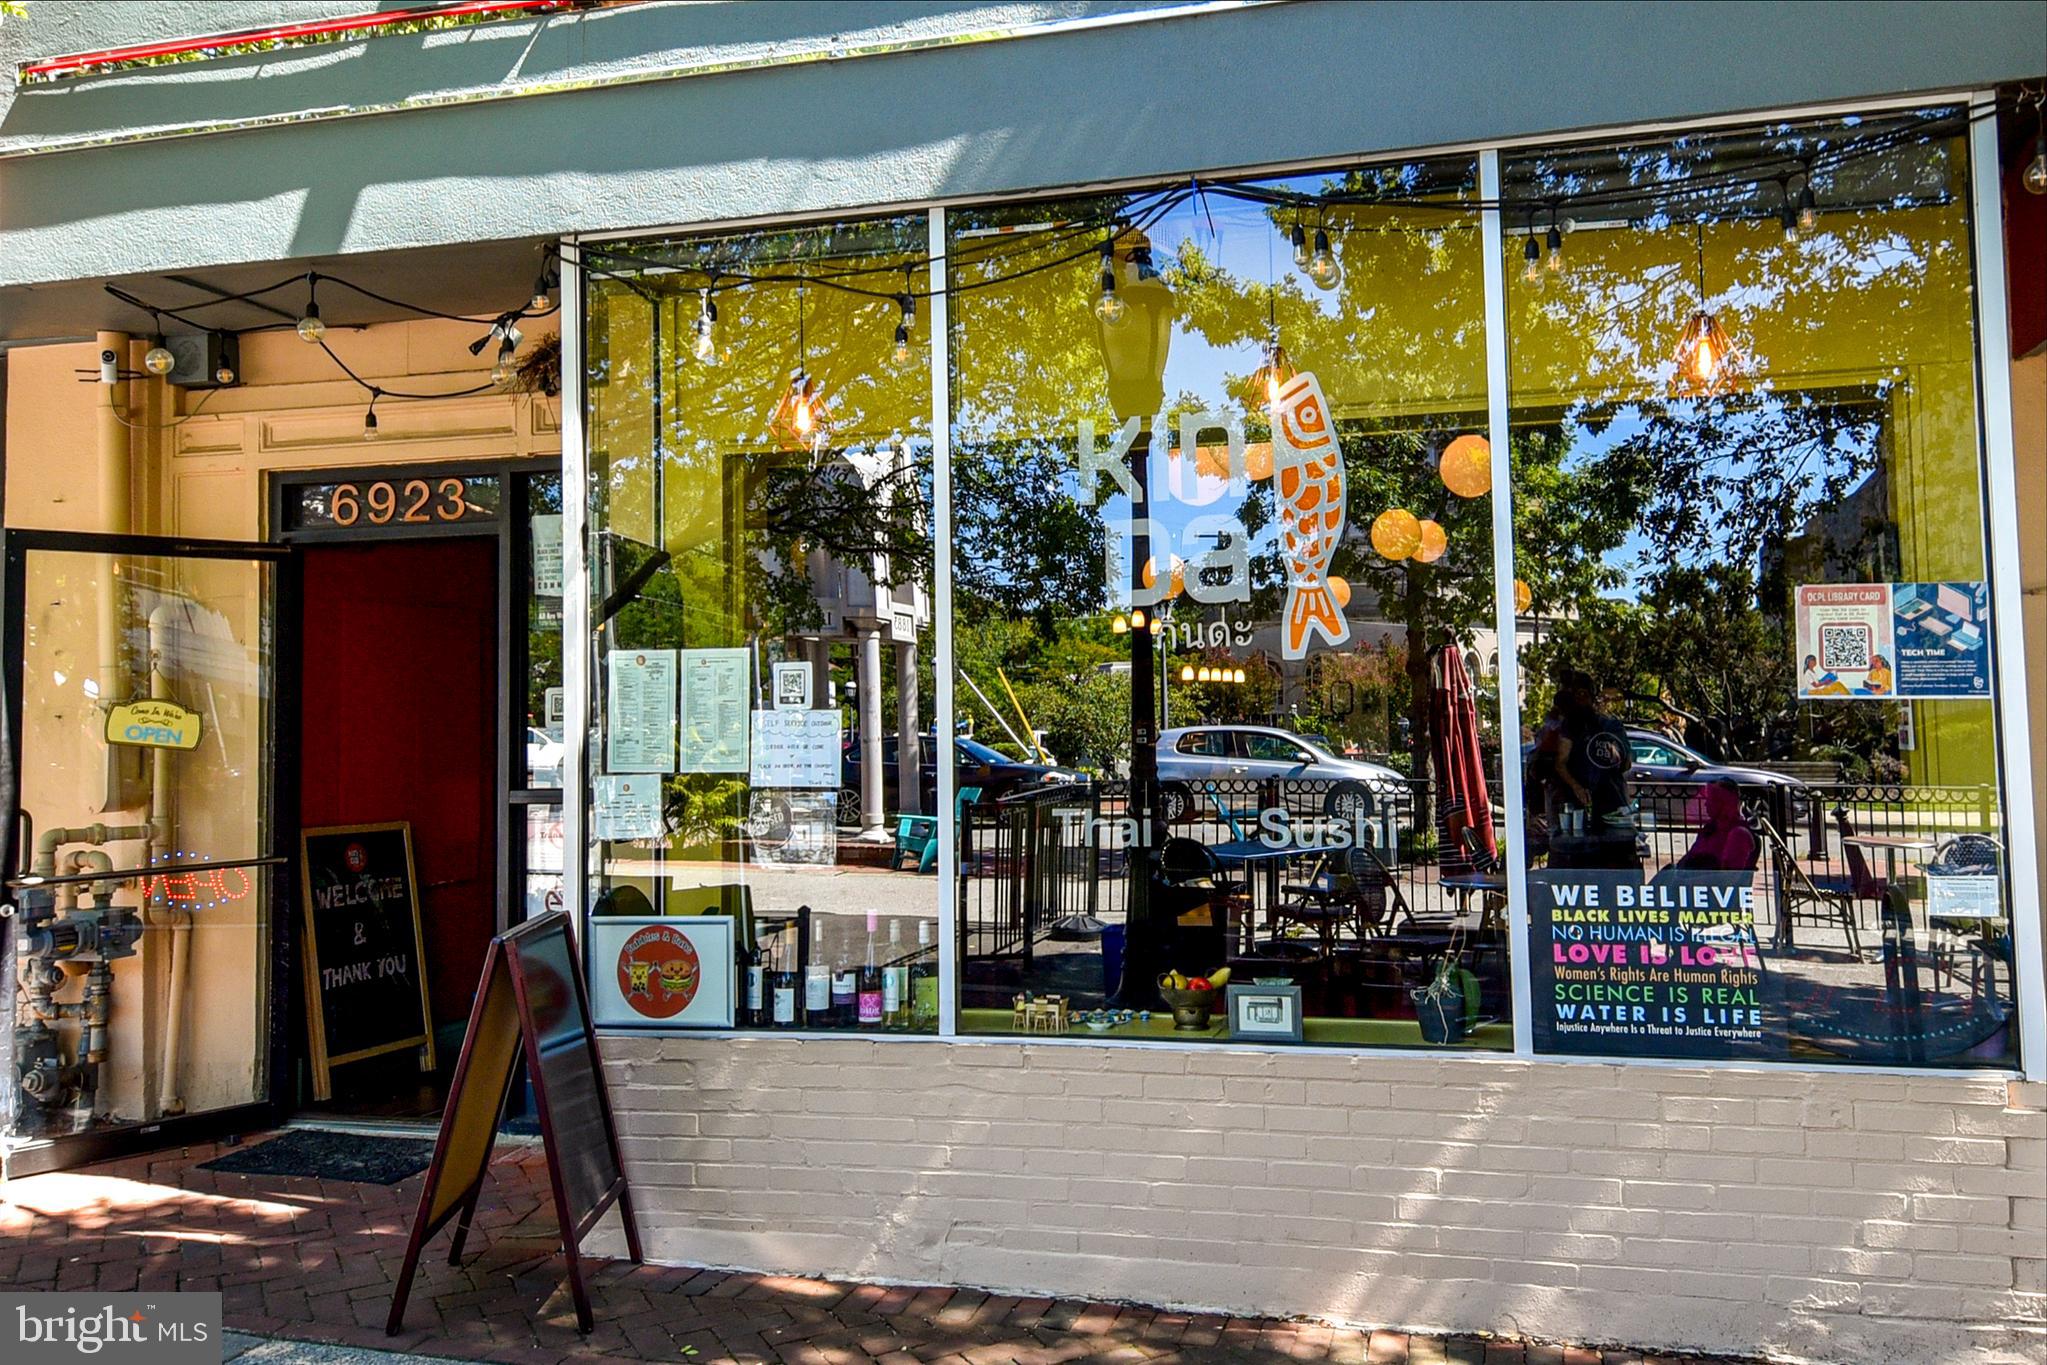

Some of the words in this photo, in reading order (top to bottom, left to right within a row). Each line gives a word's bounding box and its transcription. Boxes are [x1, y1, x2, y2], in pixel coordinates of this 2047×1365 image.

[331, 478, 466, 526] 6923
[1828, 592, 1858, 601] LIBRARY
[1859, 591, 1881, 600] CARD
[1901, 649, 1925, 657] TECH
[130, 705, 150, 715] Come
[151, 706, 160, 716] In
[125, 725, 183, 744] OPEN
[1052, 807, 1152, 848] Thai
[1259, 805, 1397, 850] Sushi
[316, 877, 404, 909] WELCOME
[1551, 884, 1599, 907] WE
[1616, 884, 1753, 908] BELIEVE
[1551, 909, 1610, 922] BLACK
[1618, 910, 1669, 923] LIVES
[1679, 910, 1754, 924] MATTER
[353, 922, 367, 945] &
[1552, 924, 1584, 941] NO
[1590, 925, 1663, 942] HUMAN
[1670, 926, 1685, 942] IS
[1553, 943, 1627, 964] LOVE
[322, 962, 372, 990] THANK
[376, 953, 407, 979] YOU
[1554, 965, 1606, 981] Women's
[1610, 966, 1645, 984] Rights
[1649, 967, 1670, 982] Are
[1674, 968, 1716, 983] Human
[1721, 968, 1758, 987] Rights
[1555, 983, 1654, 1002] SCIENCE
[1669, 986, 1689, 1003] IS
[1702, 987, 1760, 1006] REAL
[1555, 1003, 1646, 1021] WATER
[1662, 1006, 1687, 1023] IS
[1703, 1008, 1762, 1025] LIFE
[1556, 1021, 1588, 1034] Injustice
[1590, 1022, 1629, 1035] Anywhere
[1631, 1023, 1638, 1034] Is
[1639, 1026, 1645, 1034] a
[1647, 1024, 1673, 1035] Threat
[1675, 1026, 1684, 1035] to
[1685, 1026, 1712, 1037] Justice
[1714, 1026, 1762, 1039] Everywhere
